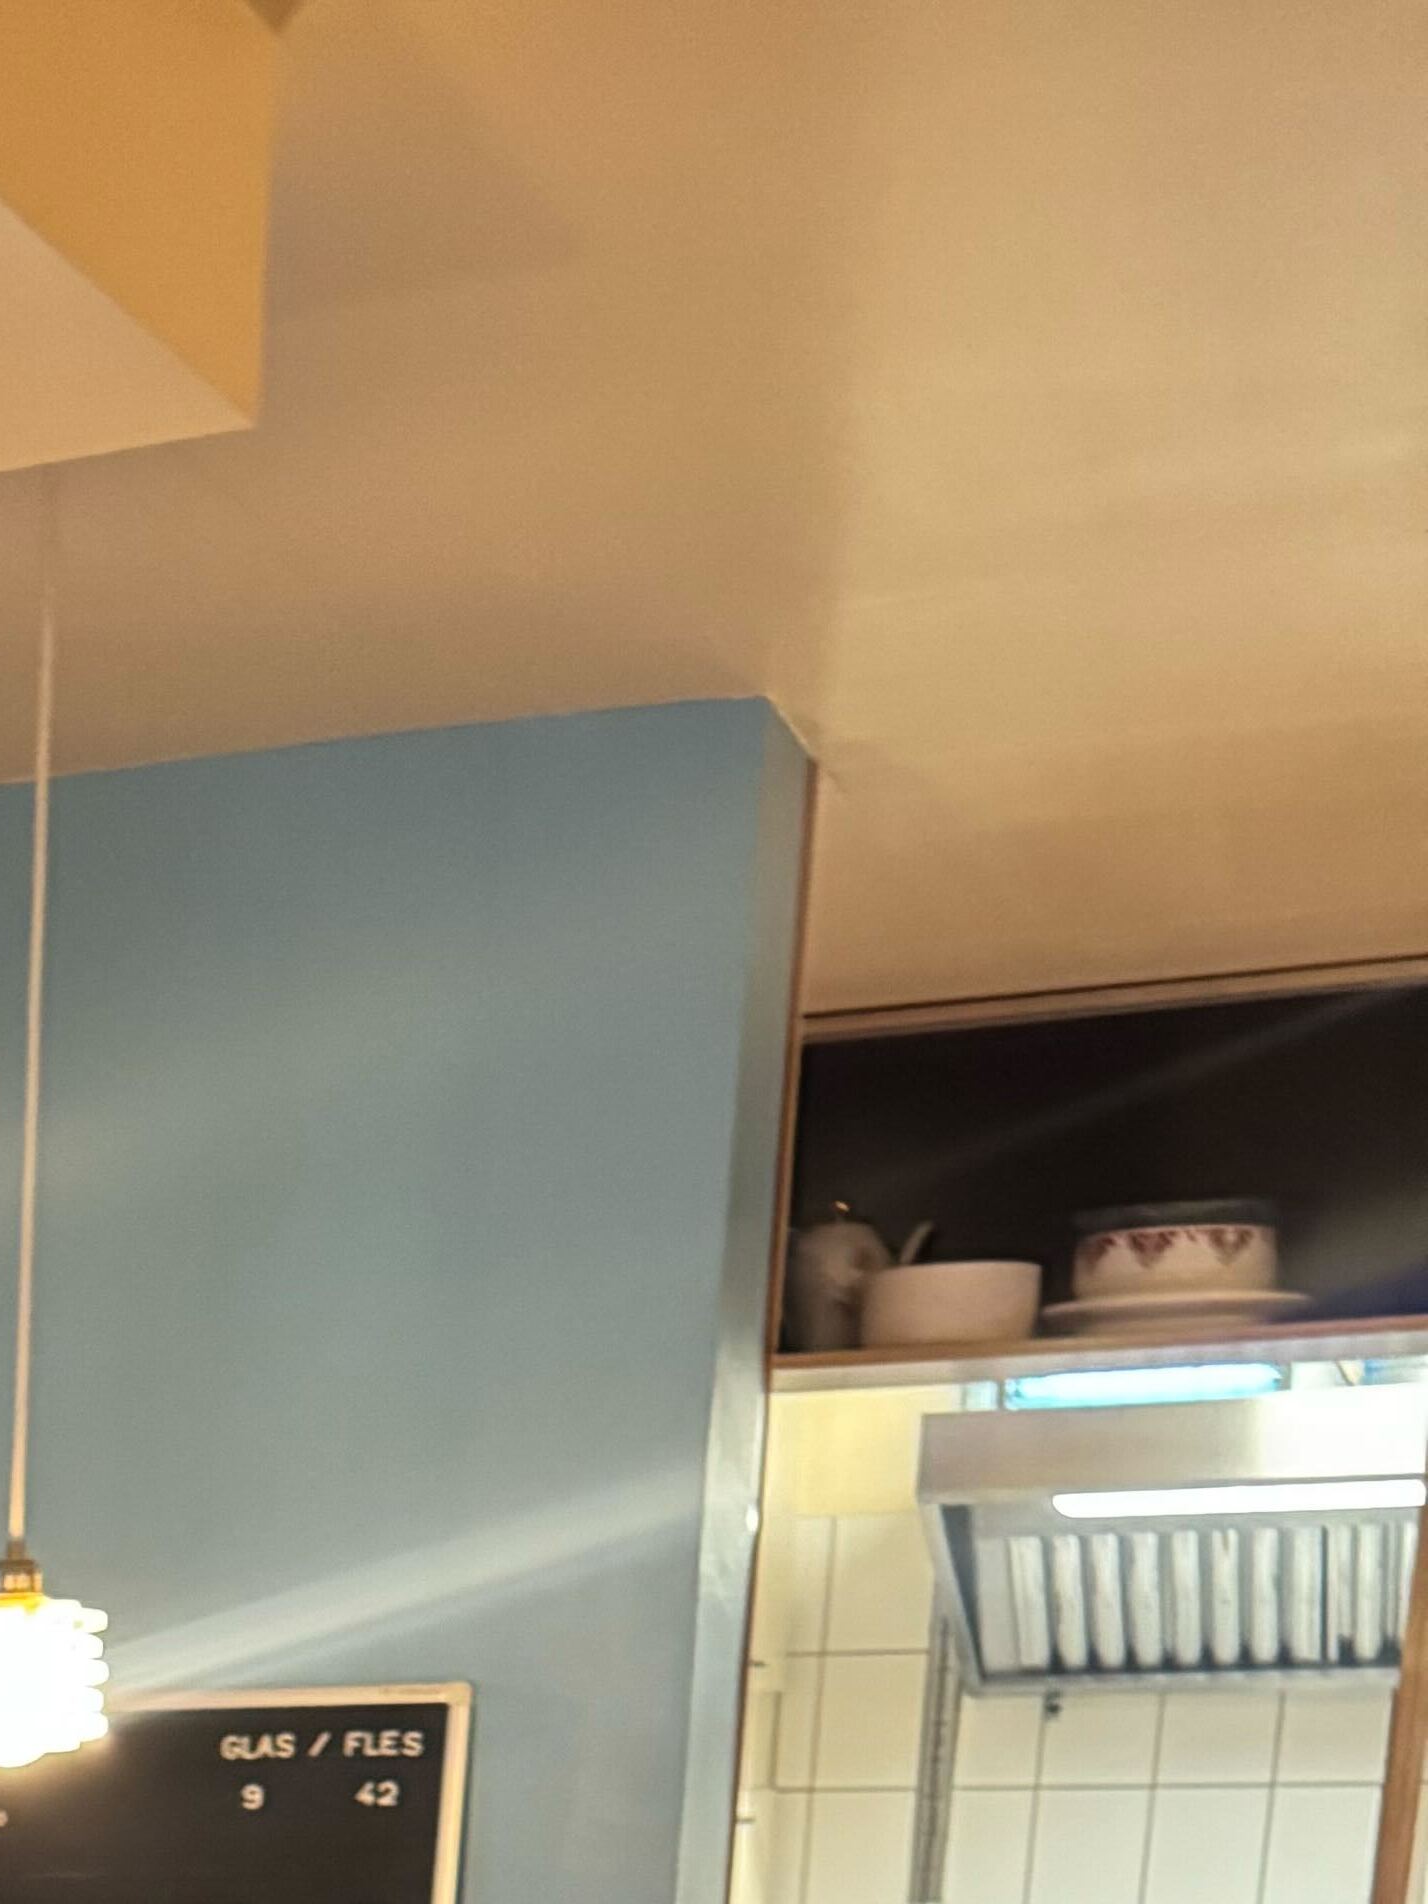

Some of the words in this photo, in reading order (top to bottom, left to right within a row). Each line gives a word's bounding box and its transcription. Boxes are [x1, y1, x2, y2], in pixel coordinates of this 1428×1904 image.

[219, 1732, 296, 1760] GLAS
[343, 1730, 424, 1757] FLES
[241, 1784, 265, 1811] 9
[354, 1780, 400, 1807] 42
